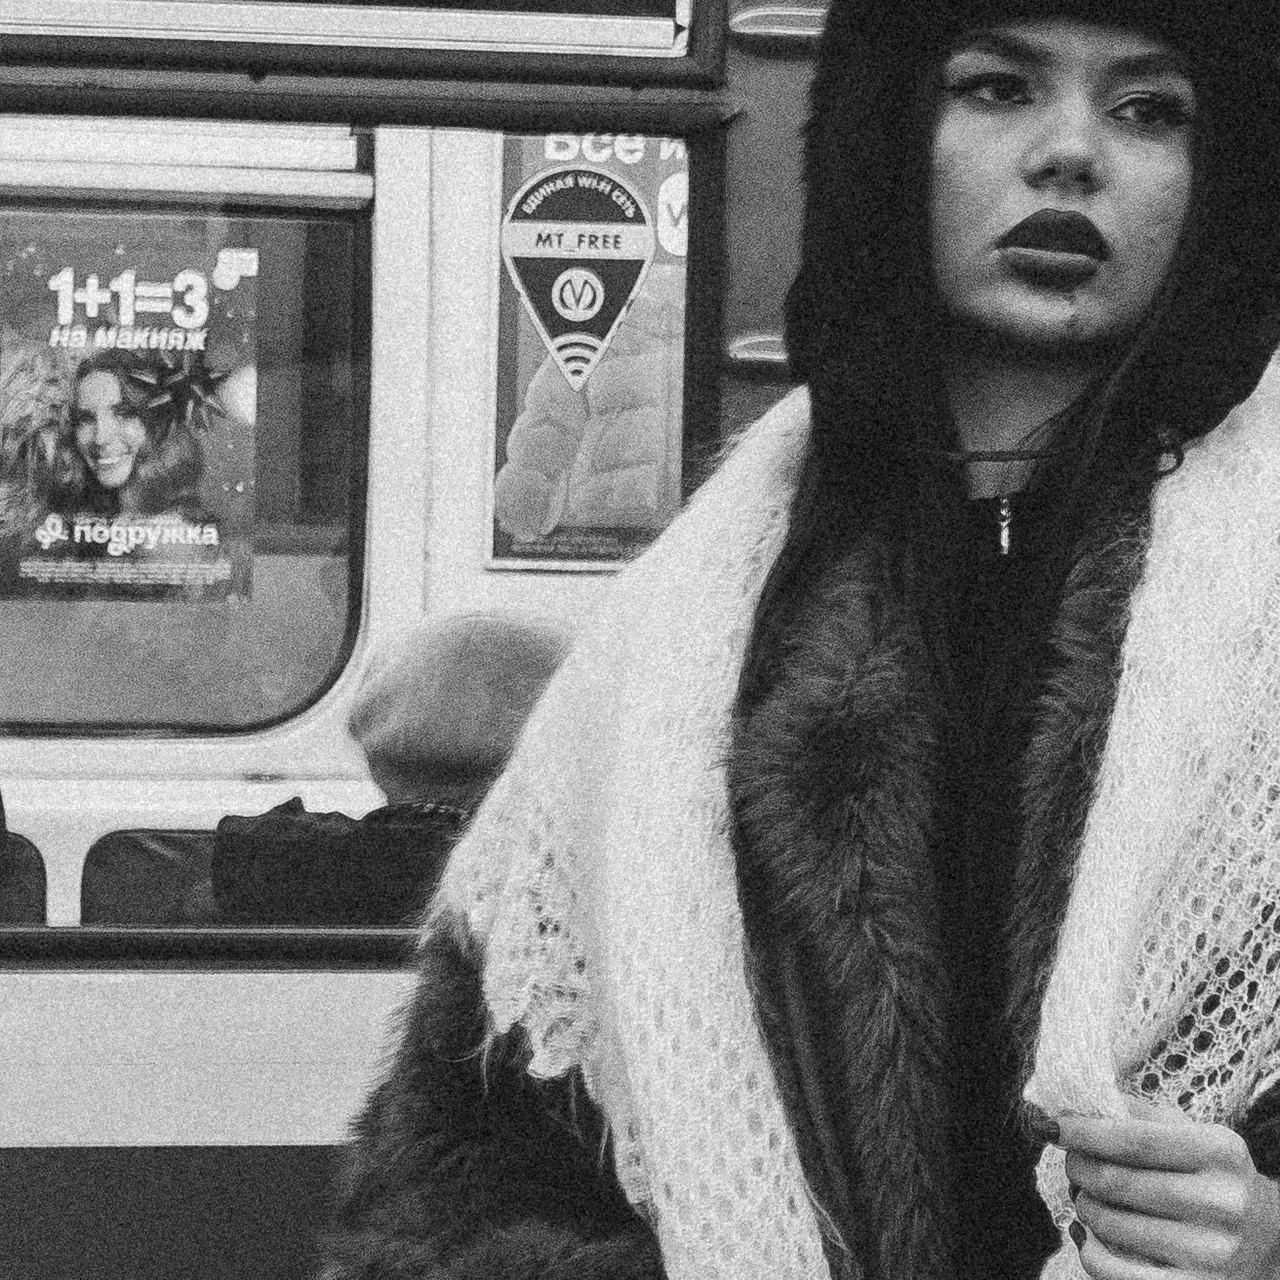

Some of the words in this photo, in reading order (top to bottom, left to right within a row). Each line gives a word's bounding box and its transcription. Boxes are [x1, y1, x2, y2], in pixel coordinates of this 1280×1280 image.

[610, 187, 637, 219] СЕТЬ
[535, 233, 622, 252] MT_FREE
[48, 267, 209, 329] 1+1=3
[49, 326, 87, 348] на
[94, 326, 208, 351] макияж
[74, 522, 219, 556] подружка
